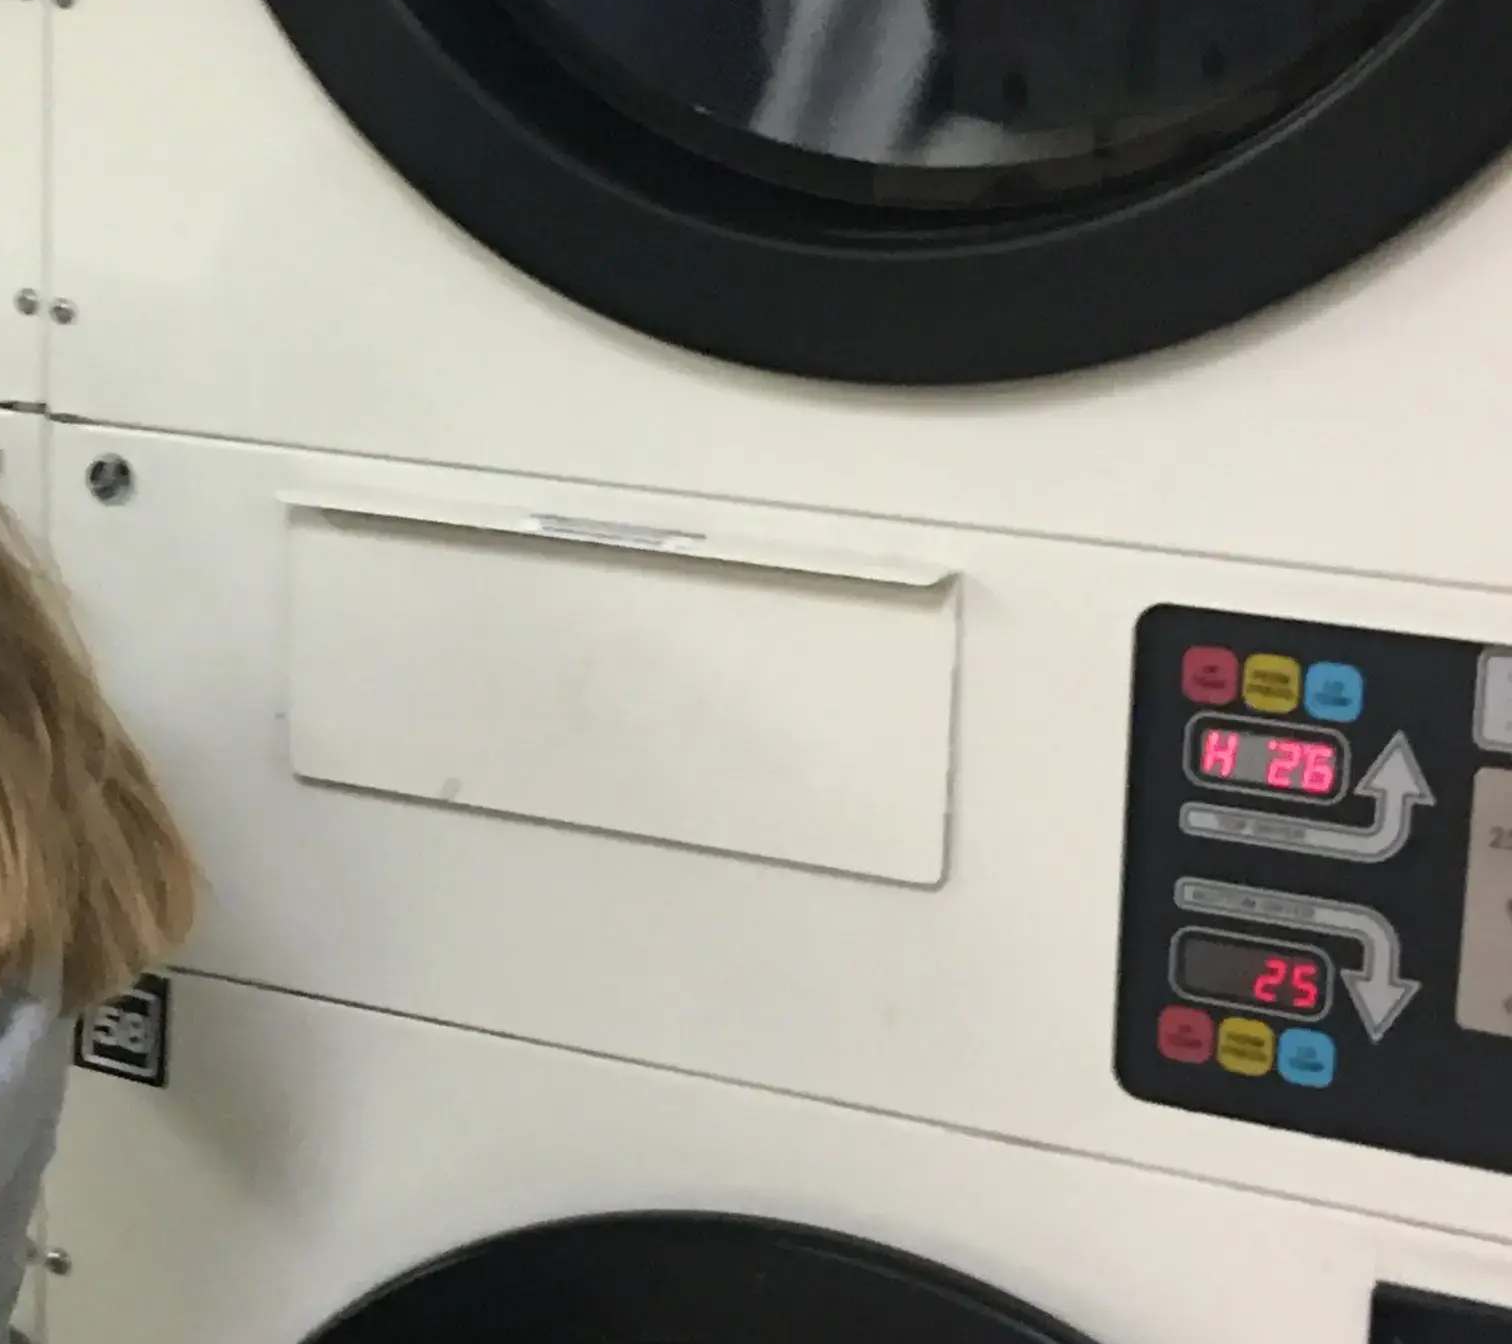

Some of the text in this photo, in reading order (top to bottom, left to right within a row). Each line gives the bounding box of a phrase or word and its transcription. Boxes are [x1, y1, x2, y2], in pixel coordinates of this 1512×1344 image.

[1202, 729, 1335, 795] H 26
[1488, 825, 1512, 851] 2
[1253, 957, 1319, 1010] 25
